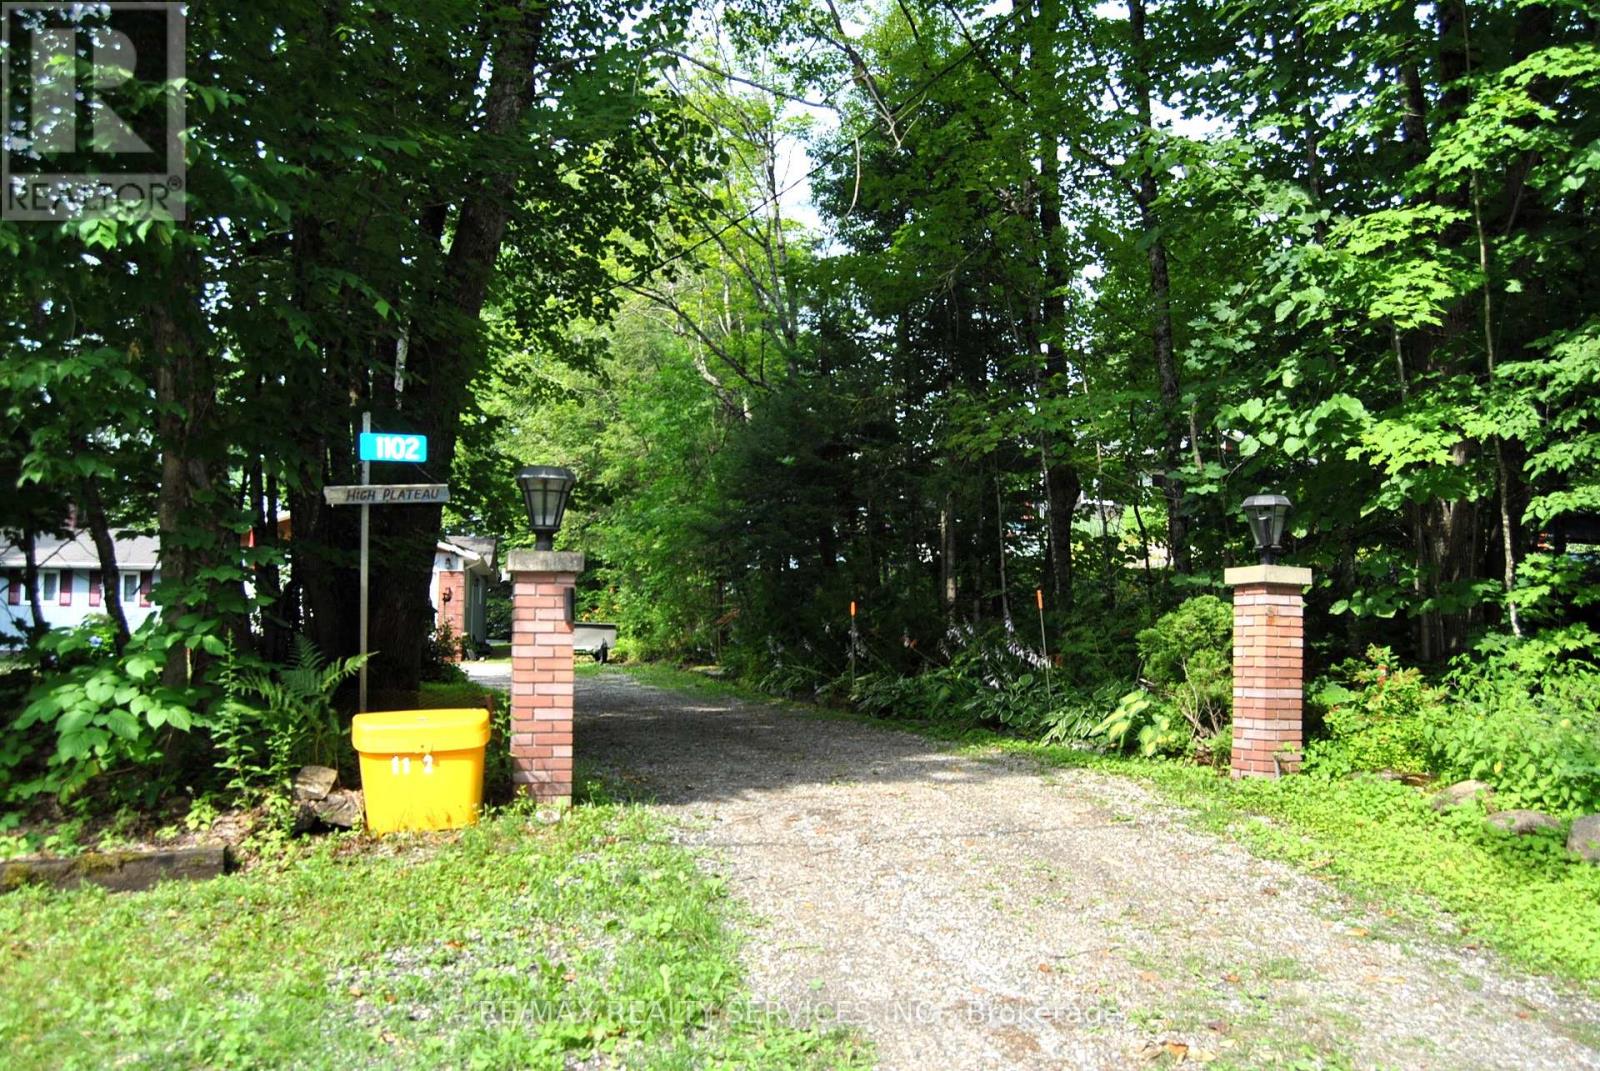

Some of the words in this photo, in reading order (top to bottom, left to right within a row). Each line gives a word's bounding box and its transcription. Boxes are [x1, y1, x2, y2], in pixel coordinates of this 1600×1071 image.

[376, 436, 419, 460] 1102
[346, 489, 375, 501] HIGH
[383, 488, 439, 501] PLATEAU
